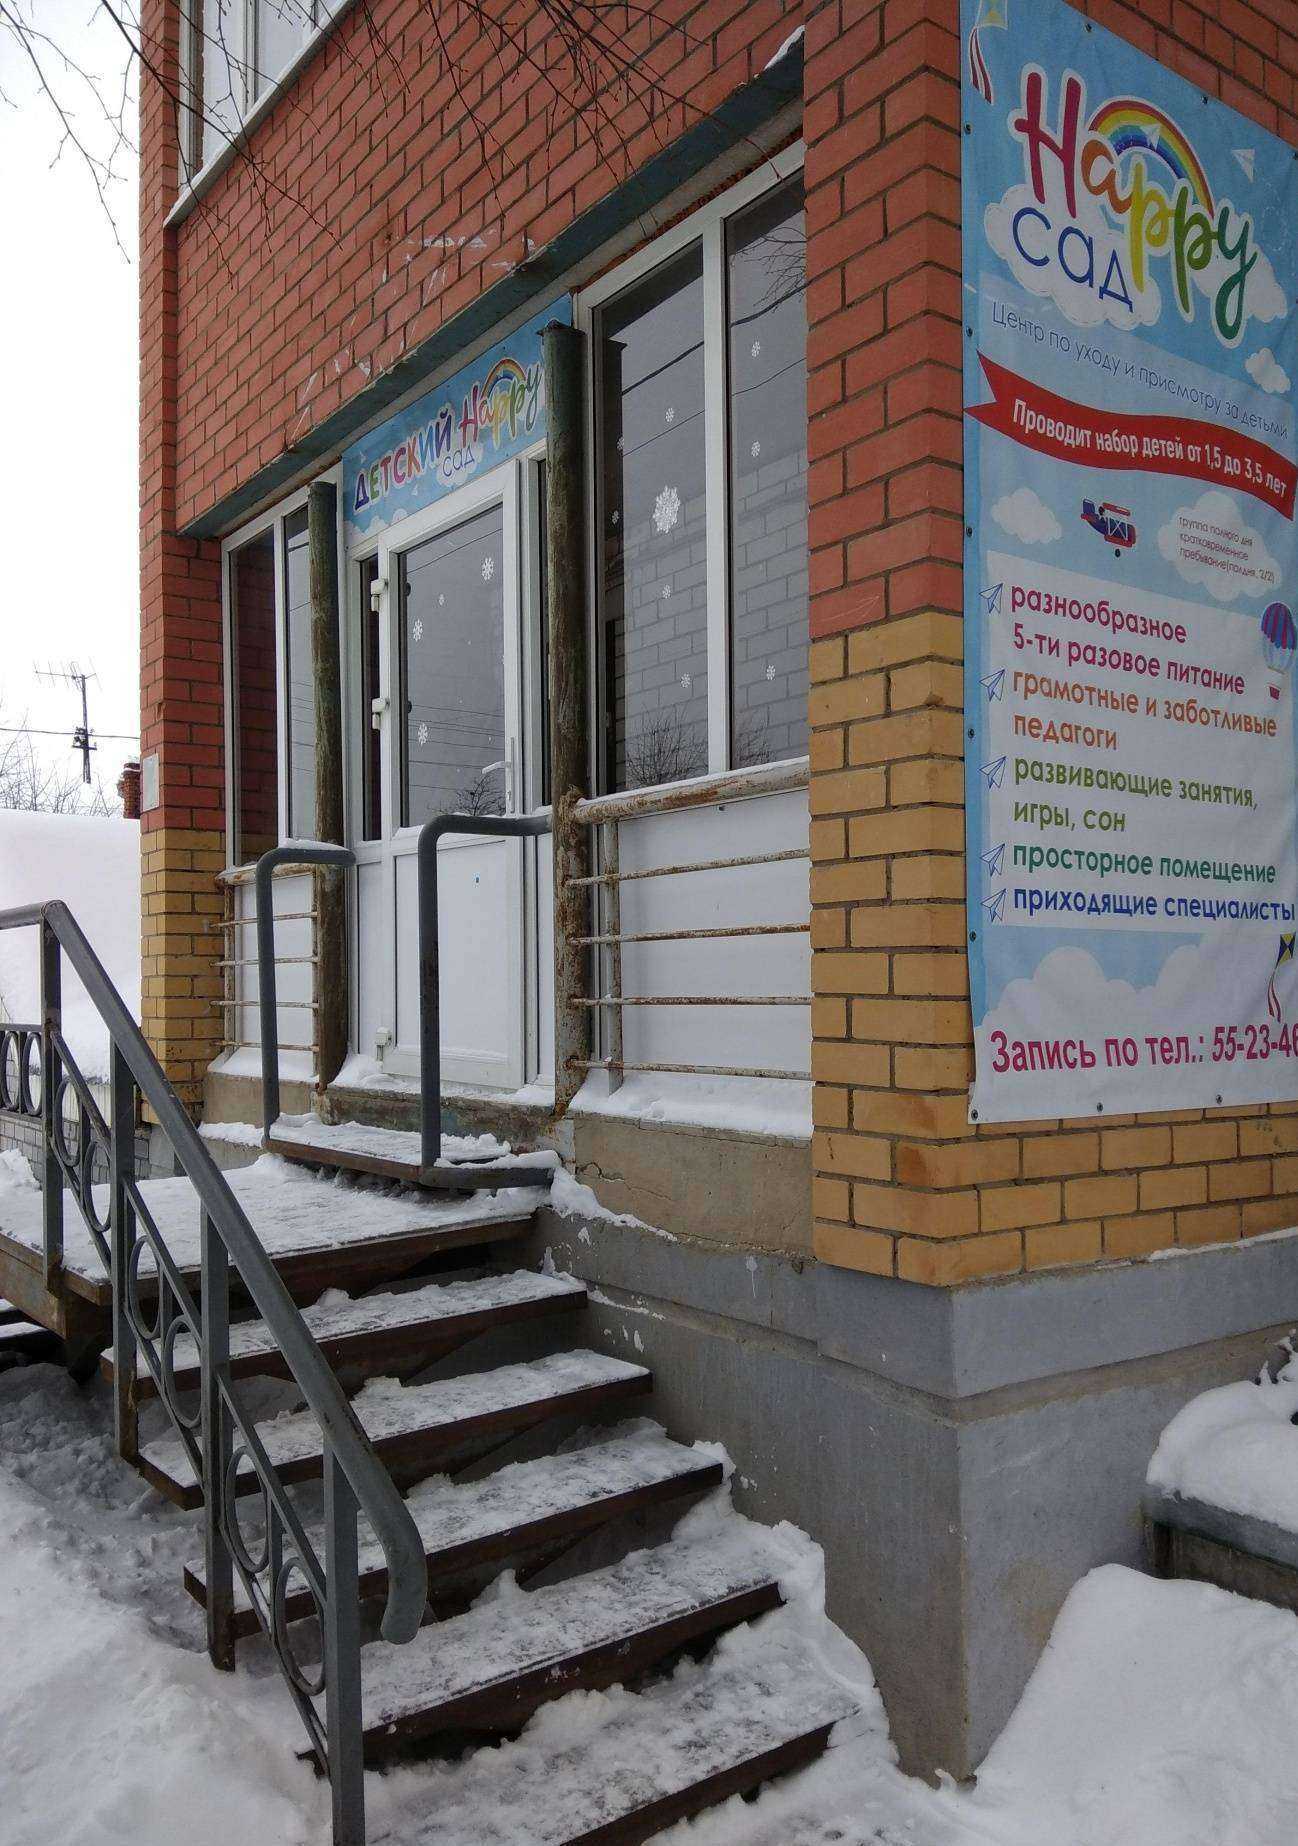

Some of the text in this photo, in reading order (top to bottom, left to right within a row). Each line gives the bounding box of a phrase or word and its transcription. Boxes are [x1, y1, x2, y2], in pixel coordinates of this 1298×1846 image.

[1015, 72, 1258, 341] Happy
[992, 301, 1289, 440] Центр по уходу и присмотру за детьми
[354, 363, 542, 511] ДЕТСКИЙ Happy
[1013, 398, 1287, 498] Проводит набор детей от 1,5 до 3,5 лет
[1011, 585, 1187, 643] разнообразное
[1014, 622, 1246, 695] 5-ти разовое питание
[1013, 671, 1277, 737] грамотные и заботливые
[1014, 714, 1117, 751] педагоги
[1014, 757, 1258, 811] развивающие занятия,
[1014, 801, 1126, 832] игры, сон
[1013, 845, 1276, 883] просторное помещение
[1014, 888, 1296, 921] приходящие специалисты
[989, 1030, 1097, 1073] Запись
[1105, 1036, 1139, 1067] по
[1145, 1032, 1204, 1065] тел.:
